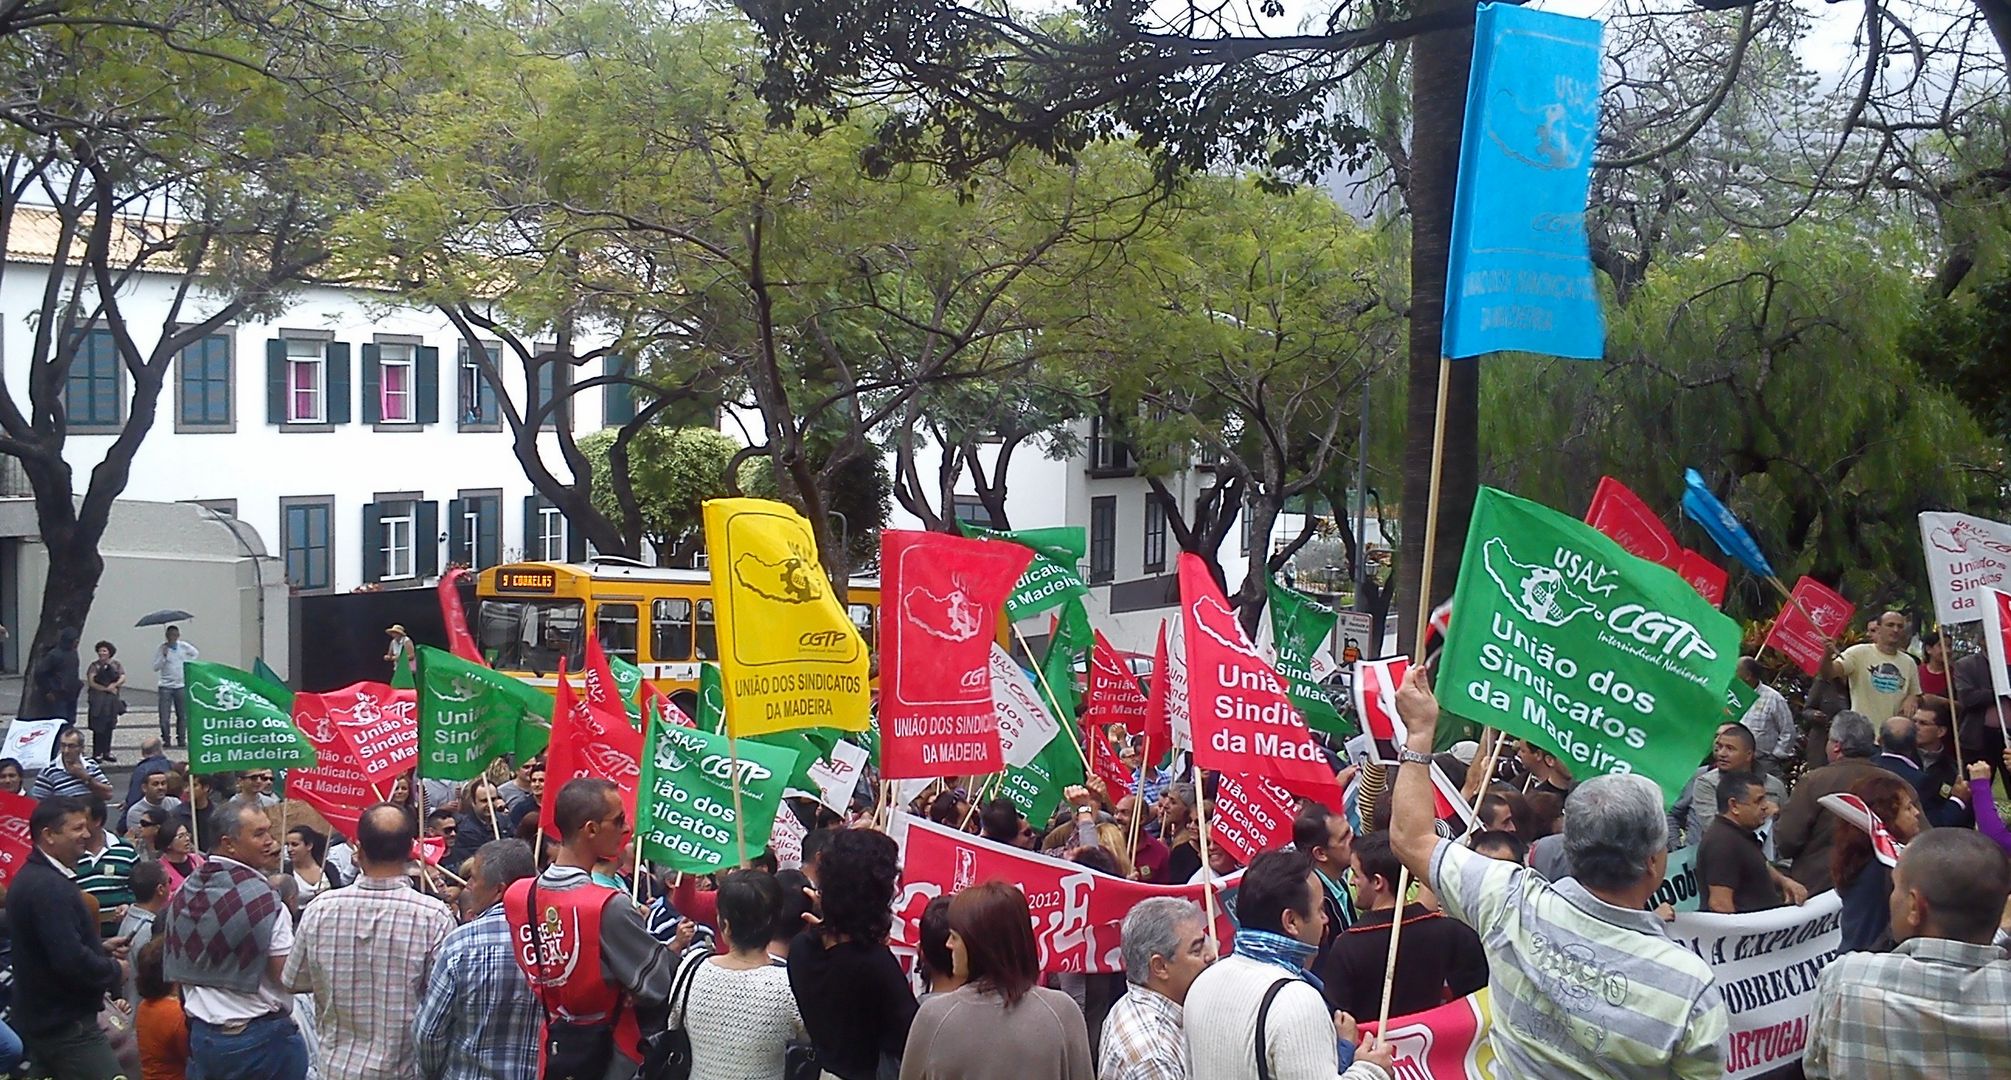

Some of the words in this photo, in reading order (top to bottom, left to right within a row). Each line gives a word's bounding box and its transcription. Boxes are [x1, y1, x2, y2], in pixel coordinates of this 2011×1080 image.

[1951, 597, 1975, 610] da
[799, 630, 847, 647] CGTP
[1608, 604, 1717, 660] CGTP
[1492, 612, 1577, 677] União
[1588, 669, 1656, 714] dos
[1597, 630, 1662, 667] Intersindical
[1662, 658, 1709, 688] Nacional
[735, 674, 770, 698] UNIÃO
[772, 674, 795, 693] DOS
[798, 673, 861, 693] SINDICATOS
[1479, 643, 1646, 749] Sindicatos
[766, 702, 782, 720] DA
[783, 698, 833, 718] MADEIRA
[996, 702, 1025, 728] dos
[1089, 705, 1106, 715] da
[203, 717, 257, 729] União
[262, 716, 289, 728] dos
[353, 720, 401, 744] União
[894, 713, 928, 738] UNIÃO
[929, 716, 953, 735] DOS
[1468, 680, 1510, 711] da
[1522, 698, 1633, 775] Madeira
[202, 732, 296, 746] Sindicatos
[1211, 728, 1247, 754] da
[200, 751, 221, 763] da
[228, 748, 299, 761] Madeira
[431, 751, 458, 764] da
[922, 744, 939, 764] DA
[939, 742, 988, 762] MADEIRA
[367, 760, 388, 774] da
[700, 754, 772, 785] CGTP
[293, 778, 312, 790] da
[316, 780, 365, 797] Madeira
[1011, 775, 1039, 795] dos
[693, 796, 736, 823] dos
[1249, 802, 1277, 831] dos
[1028, 891, 1060, 909] 2012
[1711, 936, 1726, 965] A
[1733, 909, 1843, 961] EXPLORA
